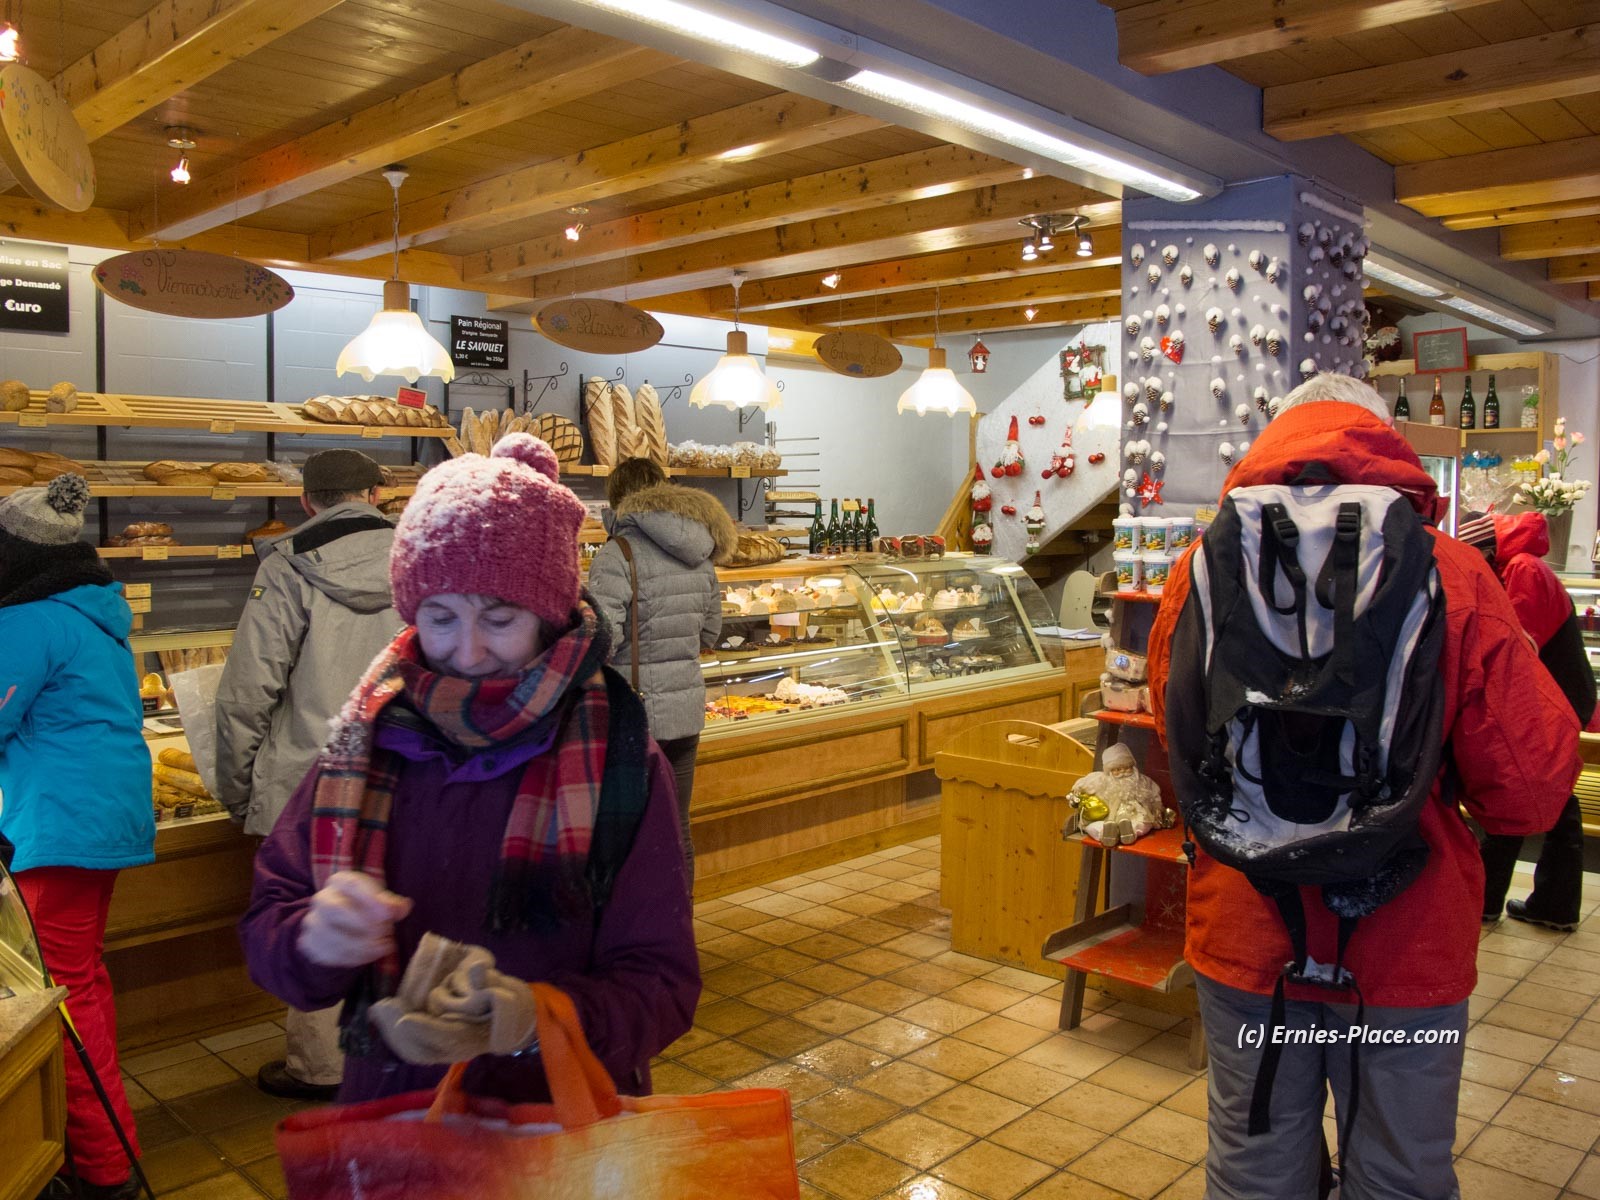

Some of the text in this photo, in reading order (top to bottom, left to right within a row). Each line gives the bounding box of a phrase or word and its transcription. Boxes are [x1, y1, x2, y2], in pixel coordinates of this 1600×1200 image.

[24, 258, 39, 267] en
[41, 258, 63, 270] Sac
[15, 278, 62, 290] Demandé
[458, 318, 501, 330] Pain Régional
[456, 340, 504, 352] LE SAVOUET
